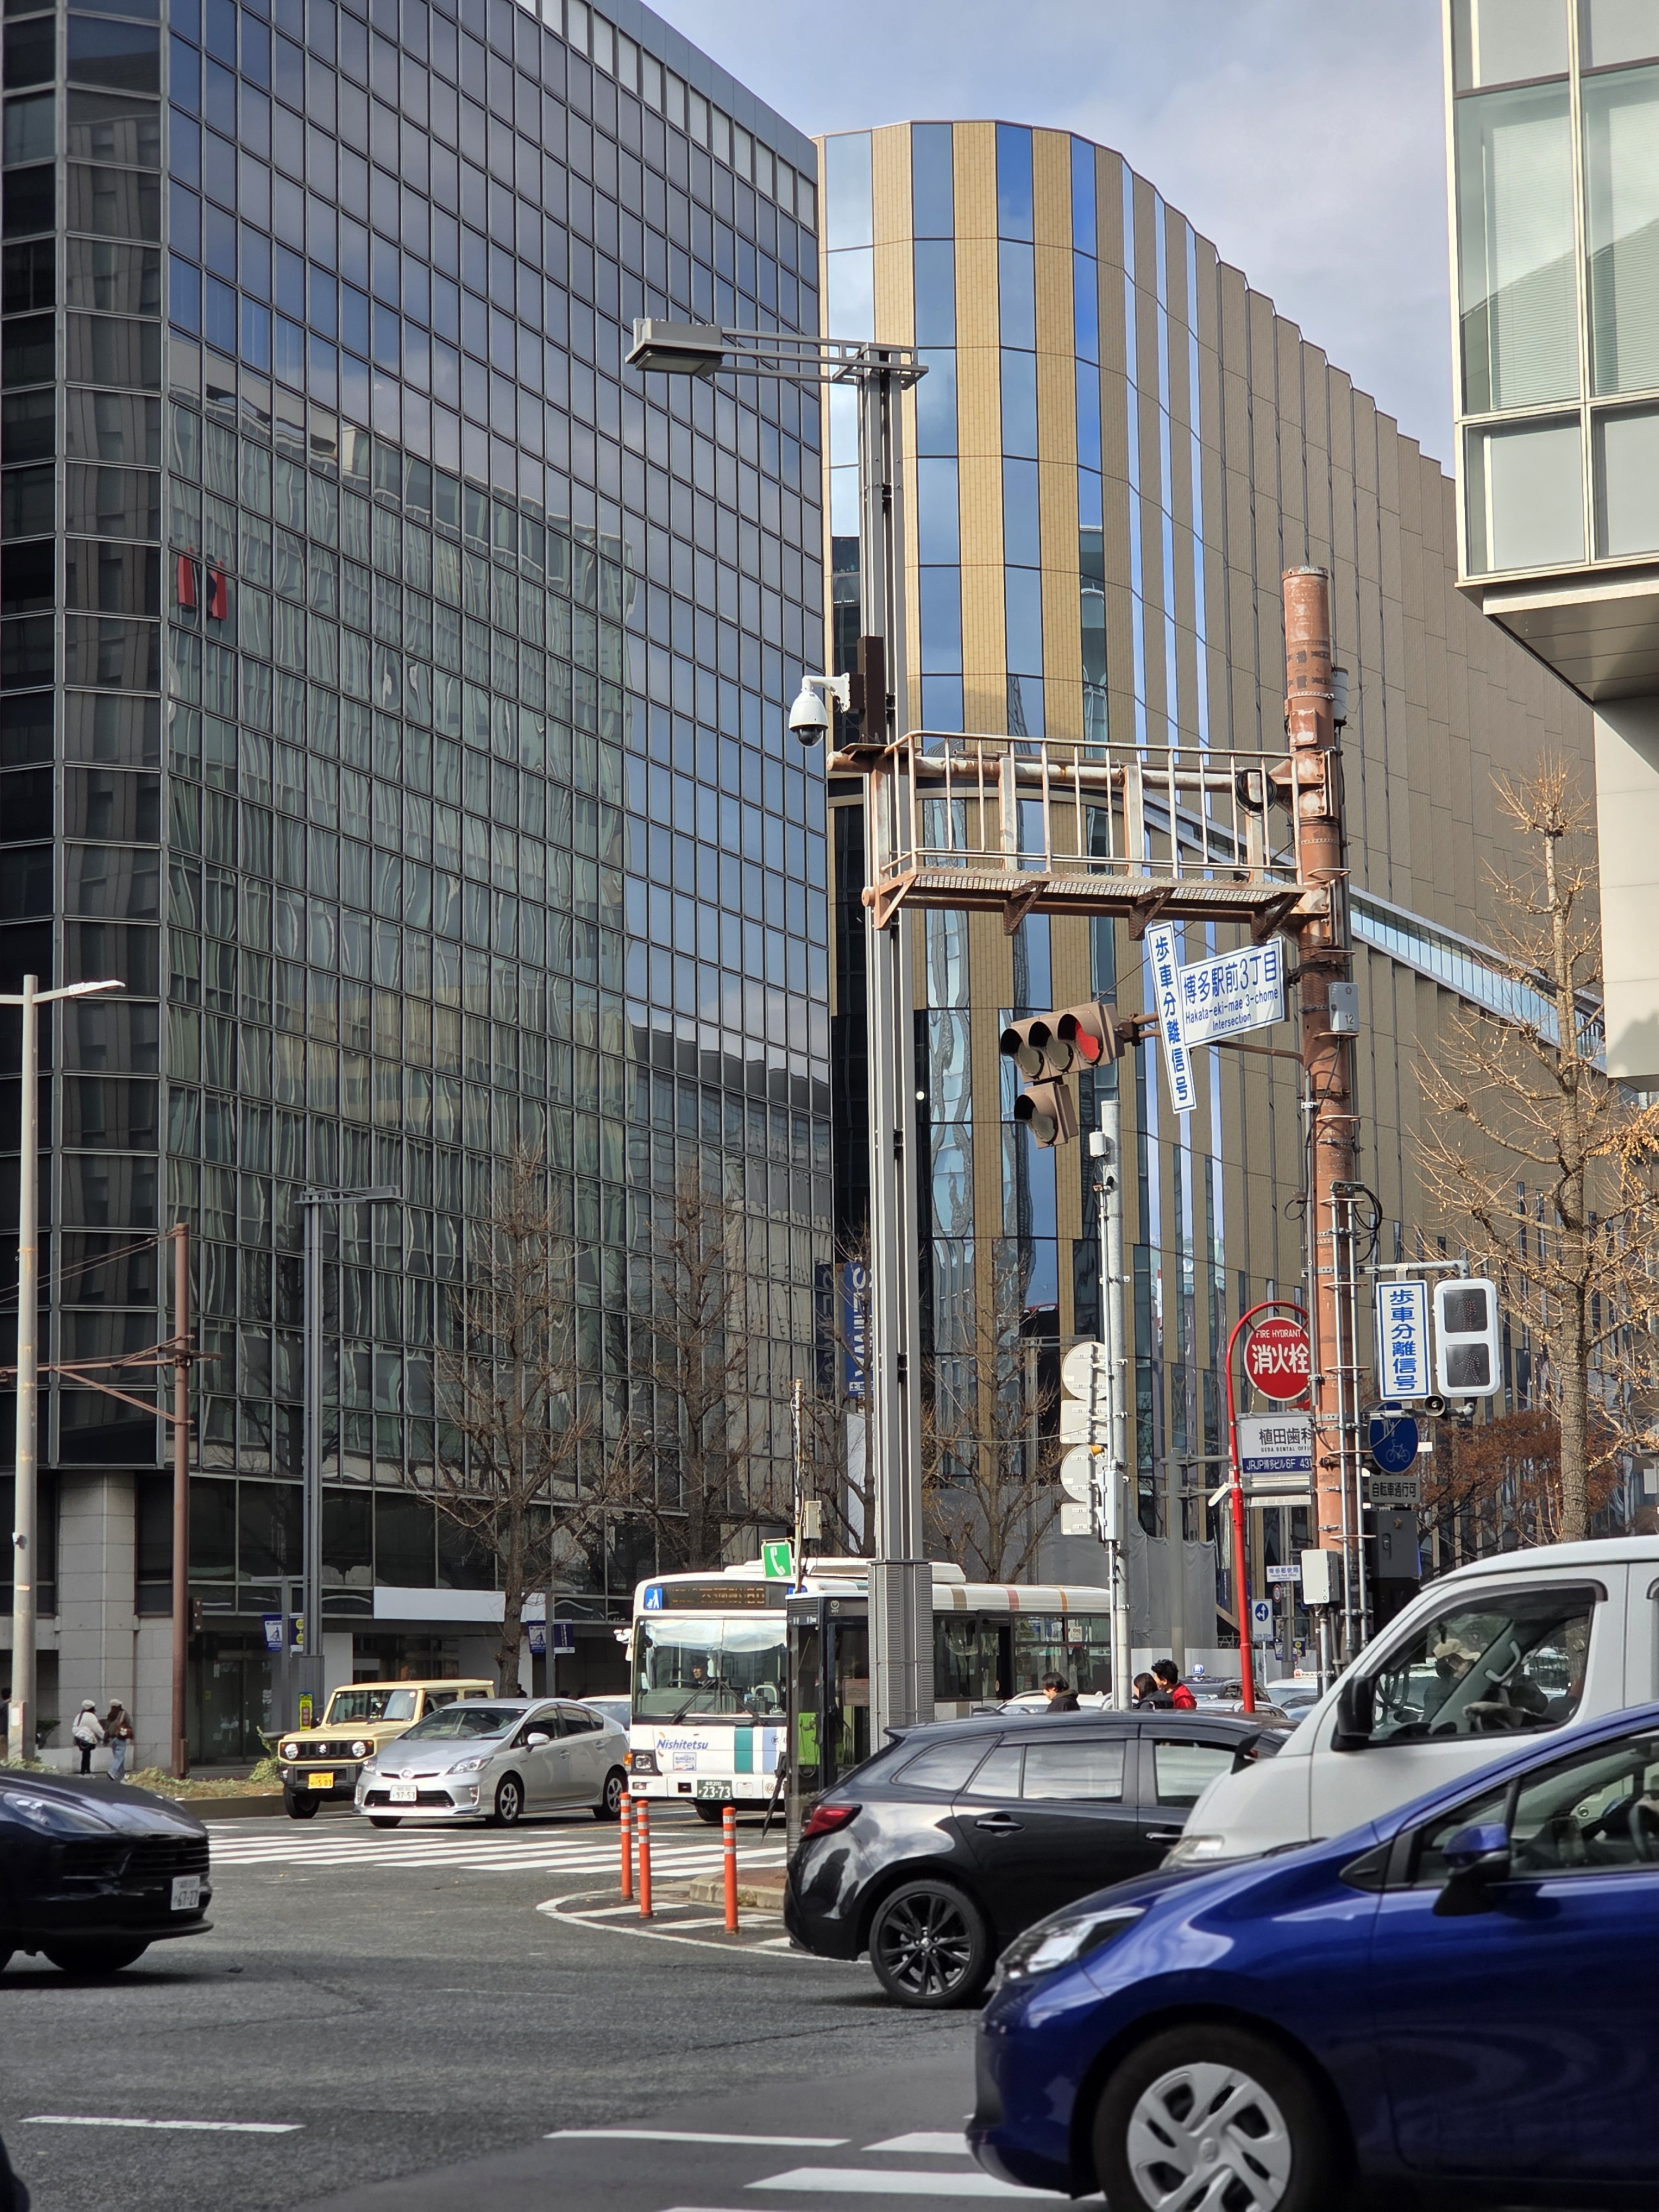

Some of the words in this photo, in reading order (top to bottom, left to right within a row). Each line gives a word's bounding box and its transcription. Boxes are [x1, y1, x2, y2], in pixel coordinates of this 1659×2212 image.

[1184, 950, 1276, 1006] 博多駅前3丁目
[1186, 999, 1243, 1024] Hakata-eki-mae
[1245, 988, 1278, 1006] 3-chome
[1155, 935, 1187, 1100] 歩車分離信号
[1213, 1013, 1251, 1031] Intersection
[1345, 1014, 1354, 1024] 12
[1256, 1329, 1270, 1338] FIRE
[1272, 1329, 1301, 1338] HYDRANT
[1390, 1289, 1418, 1390] 歩車分離信号
[1251, 1343, 1310, 1375] 消火栓
[1259, 1427, 1312, 1446] 植田歯科
[1372, 1482, 1417, 1498] 自転車通行可
[656, 1739, 708, 1750] Nishitetsu
